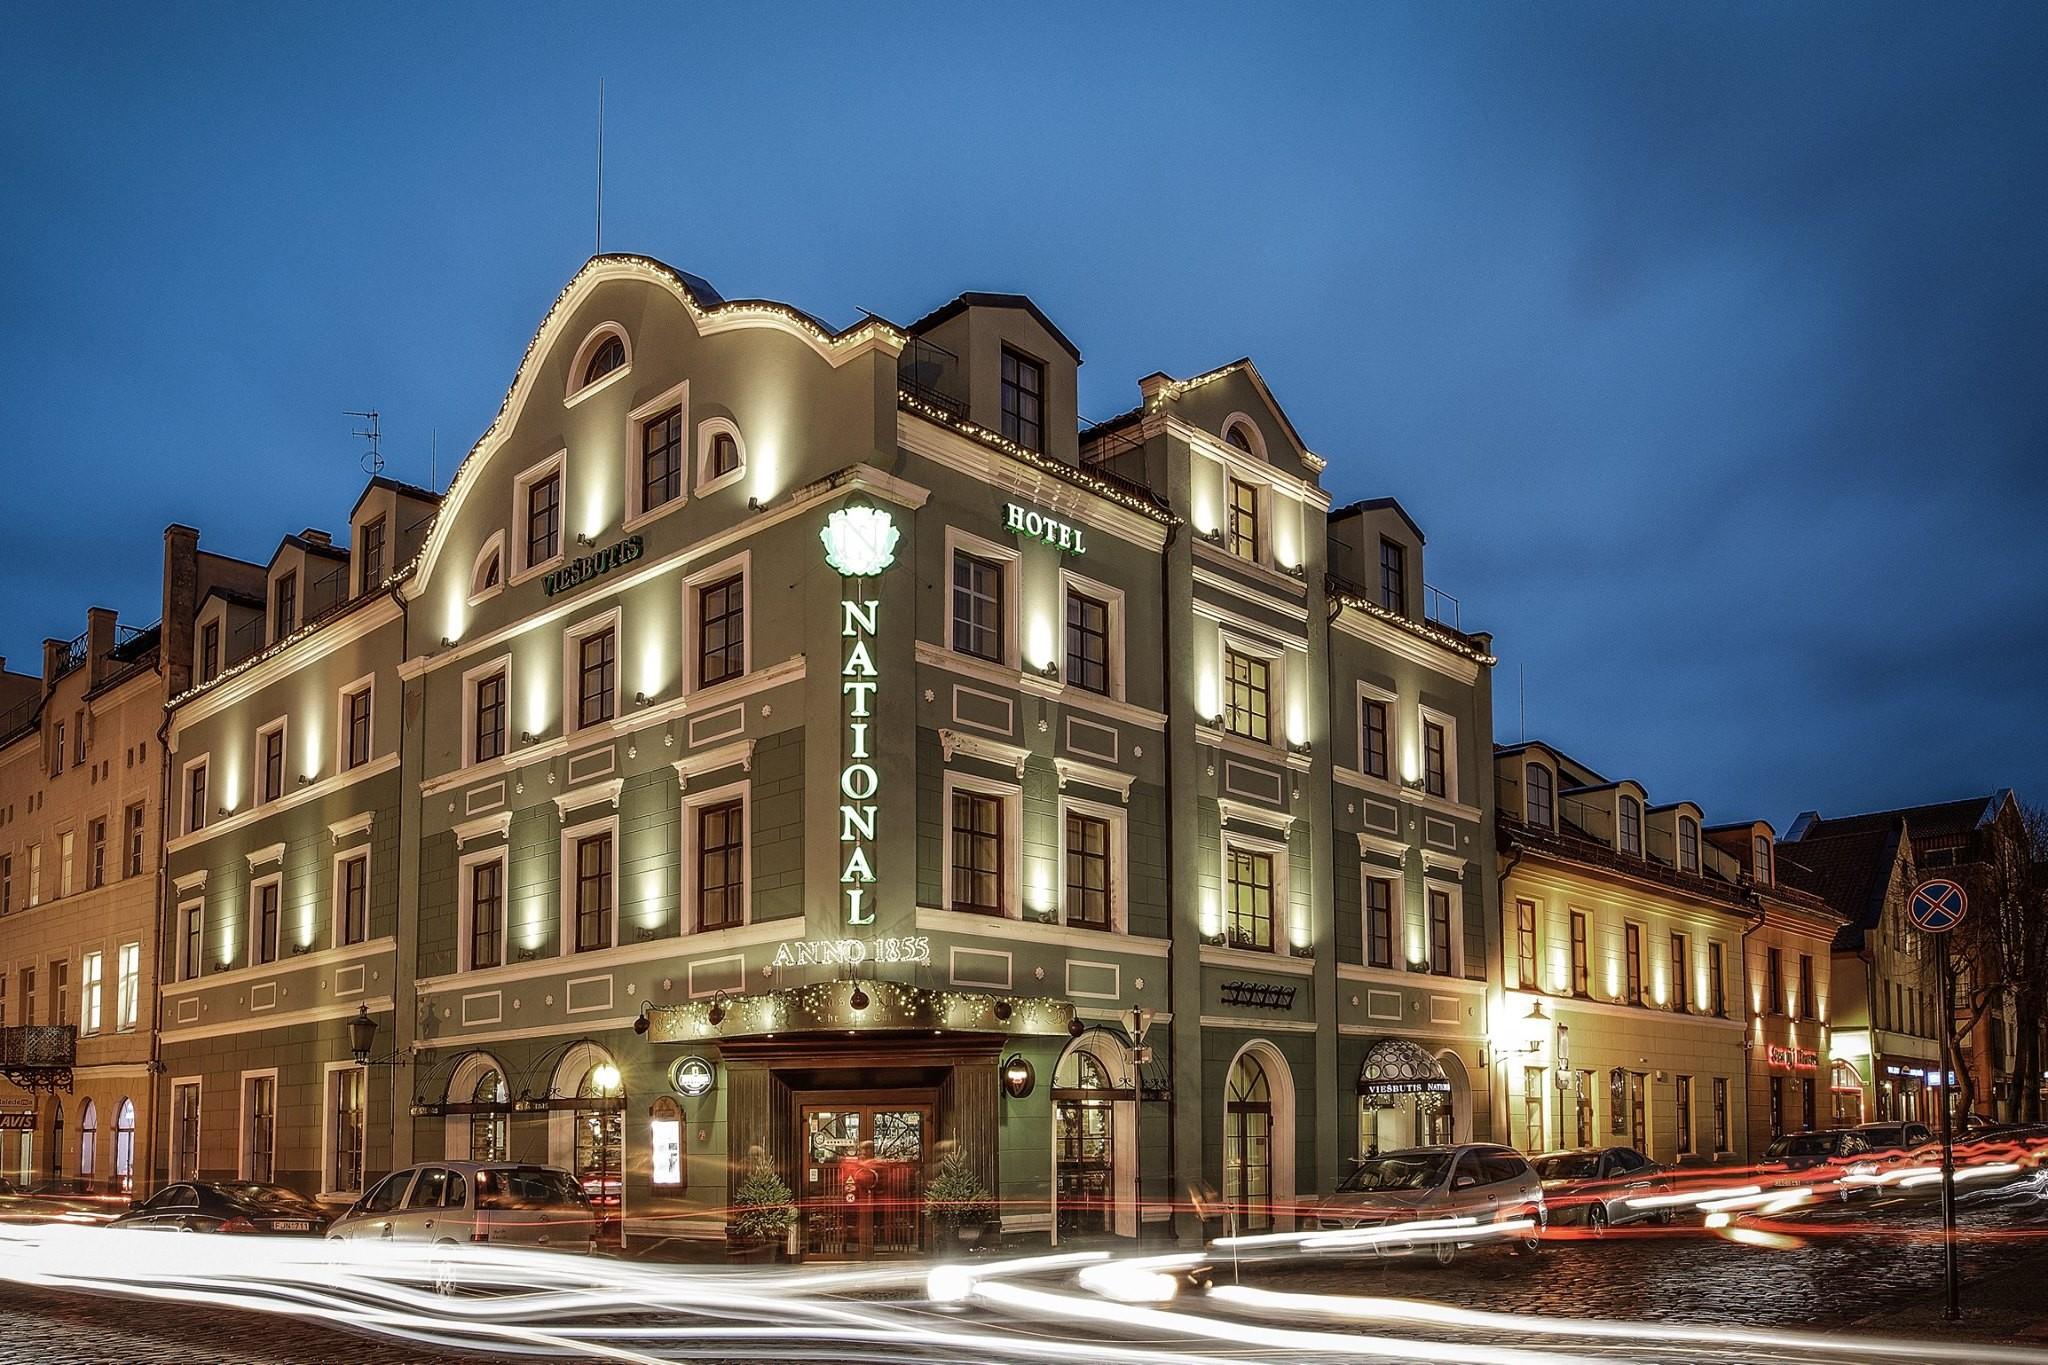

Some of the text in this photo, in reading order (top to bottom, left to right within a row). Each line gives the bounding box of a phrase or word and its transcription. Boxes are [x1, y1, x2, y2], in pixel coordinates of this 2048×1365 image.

[1007, 502, 1086, 554] HOTEL
[840, 600, 879, 925] NATIONAL
[772, 936, 930, 967] ANNO 1855
[0, 1116, 33, 1127] AVIS
